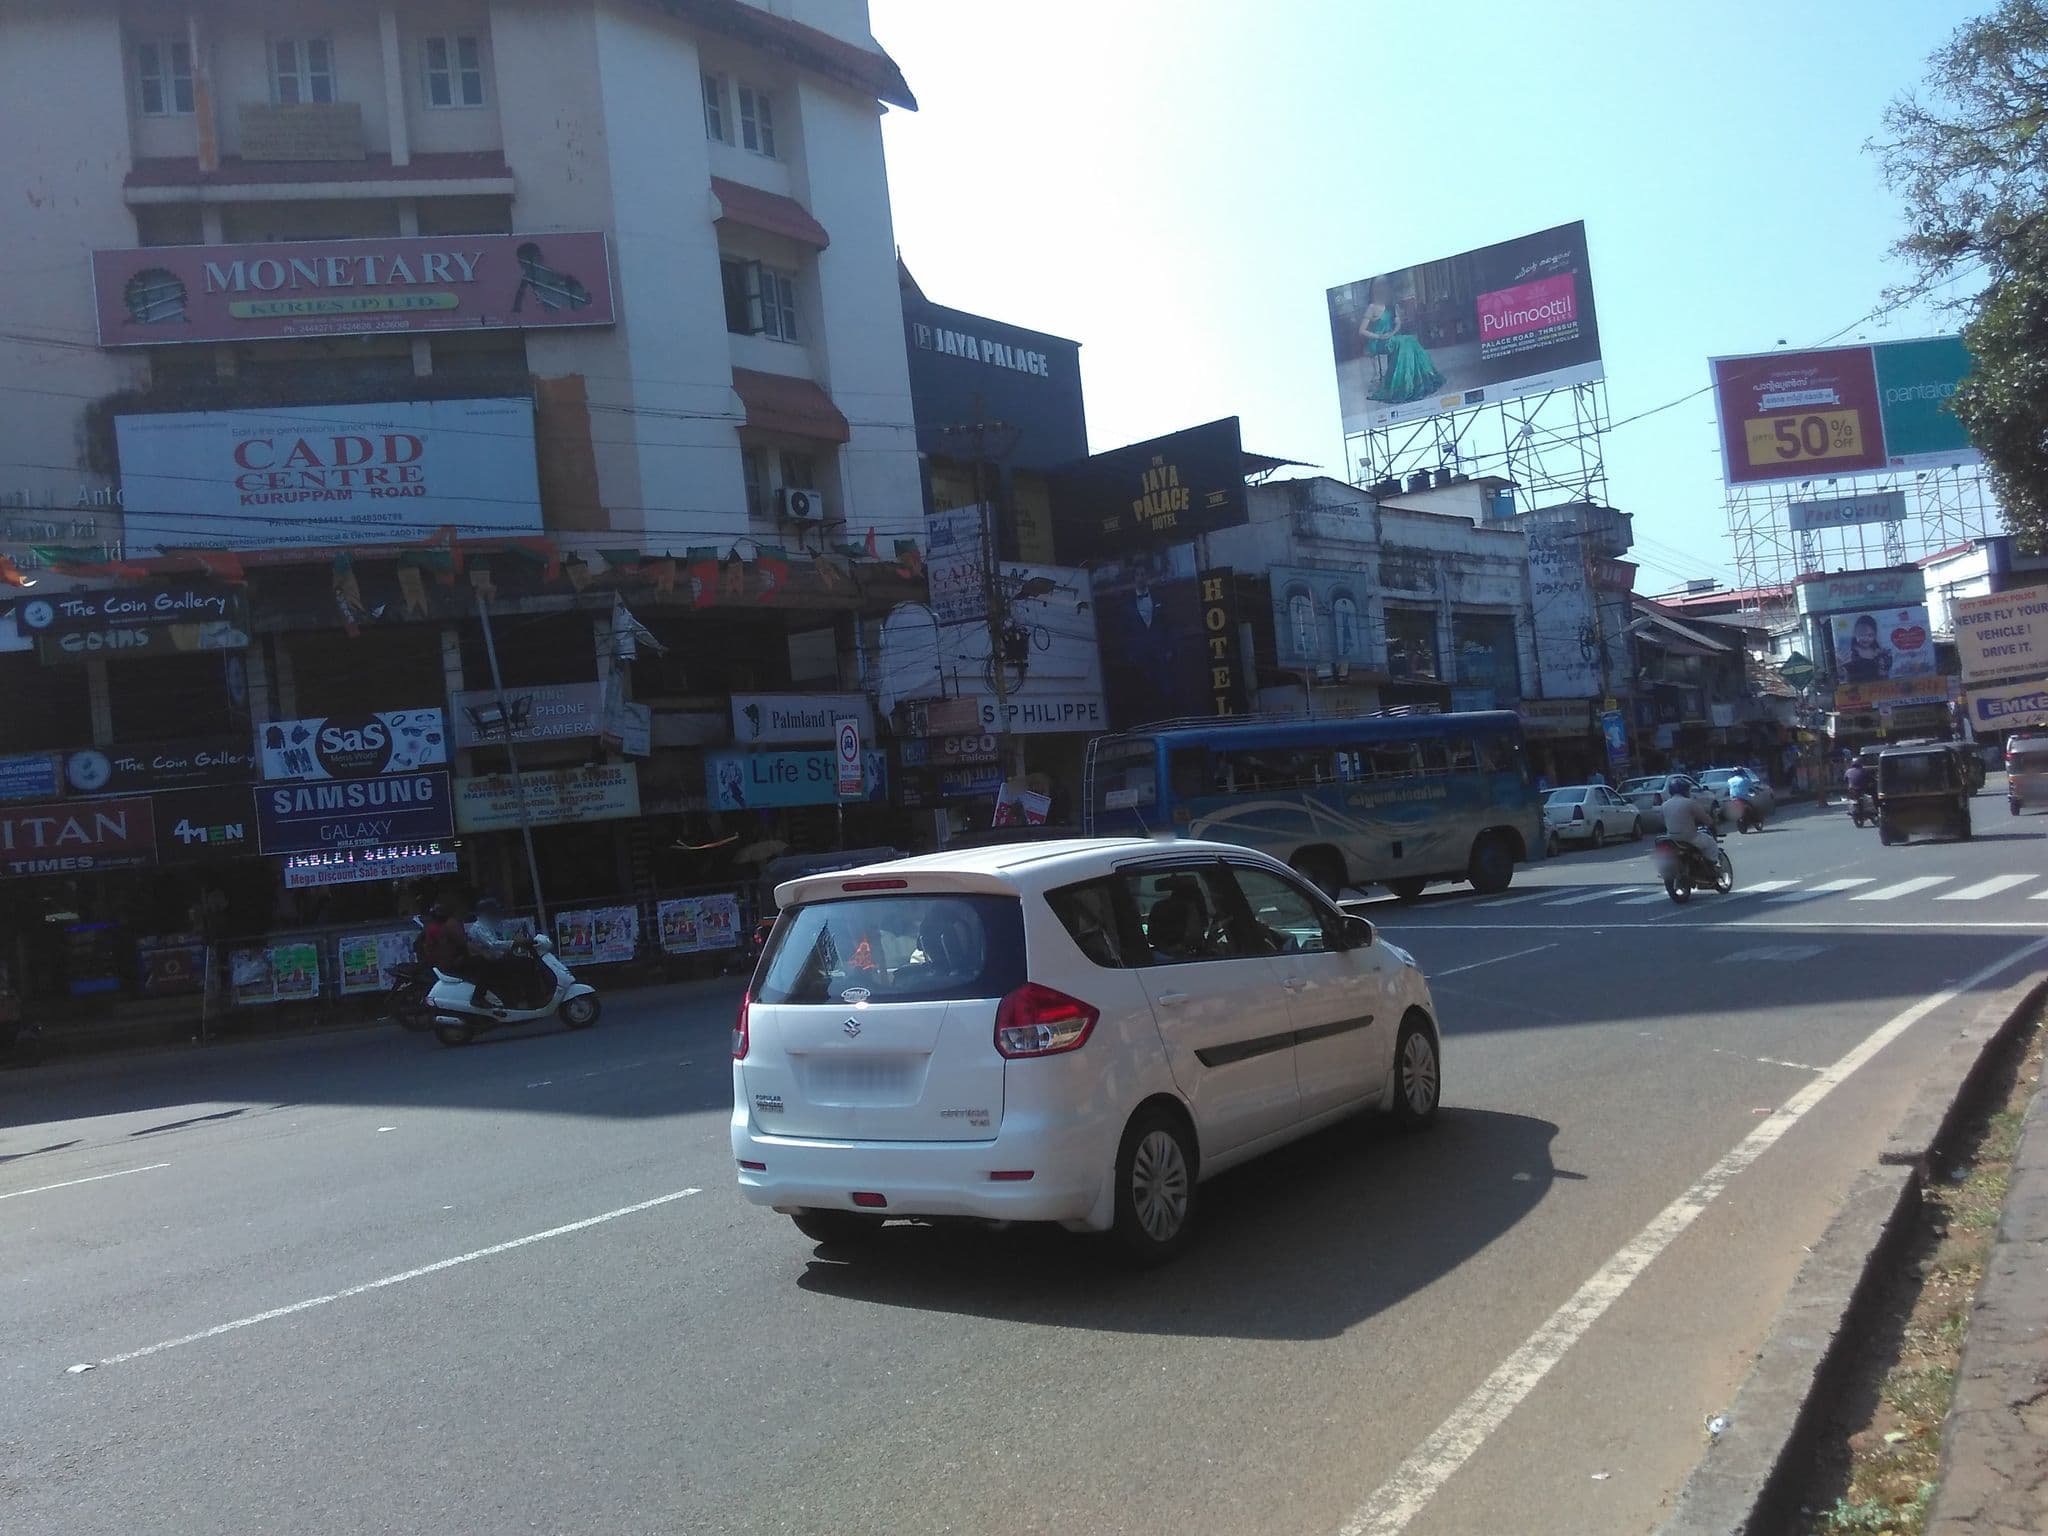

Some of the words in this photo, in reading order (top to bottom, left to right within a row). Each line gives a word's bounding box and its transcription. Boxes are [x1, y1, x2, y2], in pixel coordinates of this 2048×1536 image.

[204, 250, 488, 293] MONETARY
[251, 299, 344, 315] KURIES
[1483, 296, 1571, 332] Pulimoottil
[1482, 336, 1512, 349] PALACE
[1539, 321, 1579, 335] THRISSUR
[934, 328, 980, 360] JAYA
[981, 339, 1049, 377] PALACE
[233, 433, 424, 470] CADD
[1833, 438, 1853, 449] OFF
[234, 465, 425, 491] CENTRE
[1142, 465, 1179, 493] JAYA
[240, 488, 353, 505] KURUPPAM
[370, 485, 426, 498] ROAD
[1132, 488, 1190, 522] PALACE
[1151, 513, 1177, 531] HOTEL
[60, 600, 96, 617] The
[104, 597, 147, 614] Coin
[154, 592, 226, 616] Gallery
[1960, 602, 1976, 611] CITY
[1978, 596, 2009, 607] TRAFFIC
[2010, 591, 2037, 601] POLICE
[1955, 612, 1992, 626] NEVER
[1995, 608, 2014, 620] FLY
[2017, 602, 2048, 616] YOUR
[1976, 625, 2025, 641] VEHICLE
[1203, 578, 1233, 717] HOTEL
[1982, 643, 2016, 658] DRIVE
[535, 703, 585, 717] PHONE
[772, 709, 825, 729] Palmland
[1009, 703, 1100, 723] PHILIPPE
[321, 724, 386, 754] SaS
[531, 721, 594, 738] CAMERA
[115, 758, 145, 772] The
[152, 755, 187, 769] Coin
[195, 751, 256, 768] Gallery
[752, 757, 798, 784] Life
[273, 777, 432, 814] SAMSUNG
[320, 819, 392, 840] GALAXY
[9, 855, 96, 874] TIMES
[290, 872, 316, 886] Mega
[318, 868, 357, 882] Discount
[359, 866, 379, 879] Sale
[381, 865, 389, 877] &
[390, 861, 433, 875] Exchange
